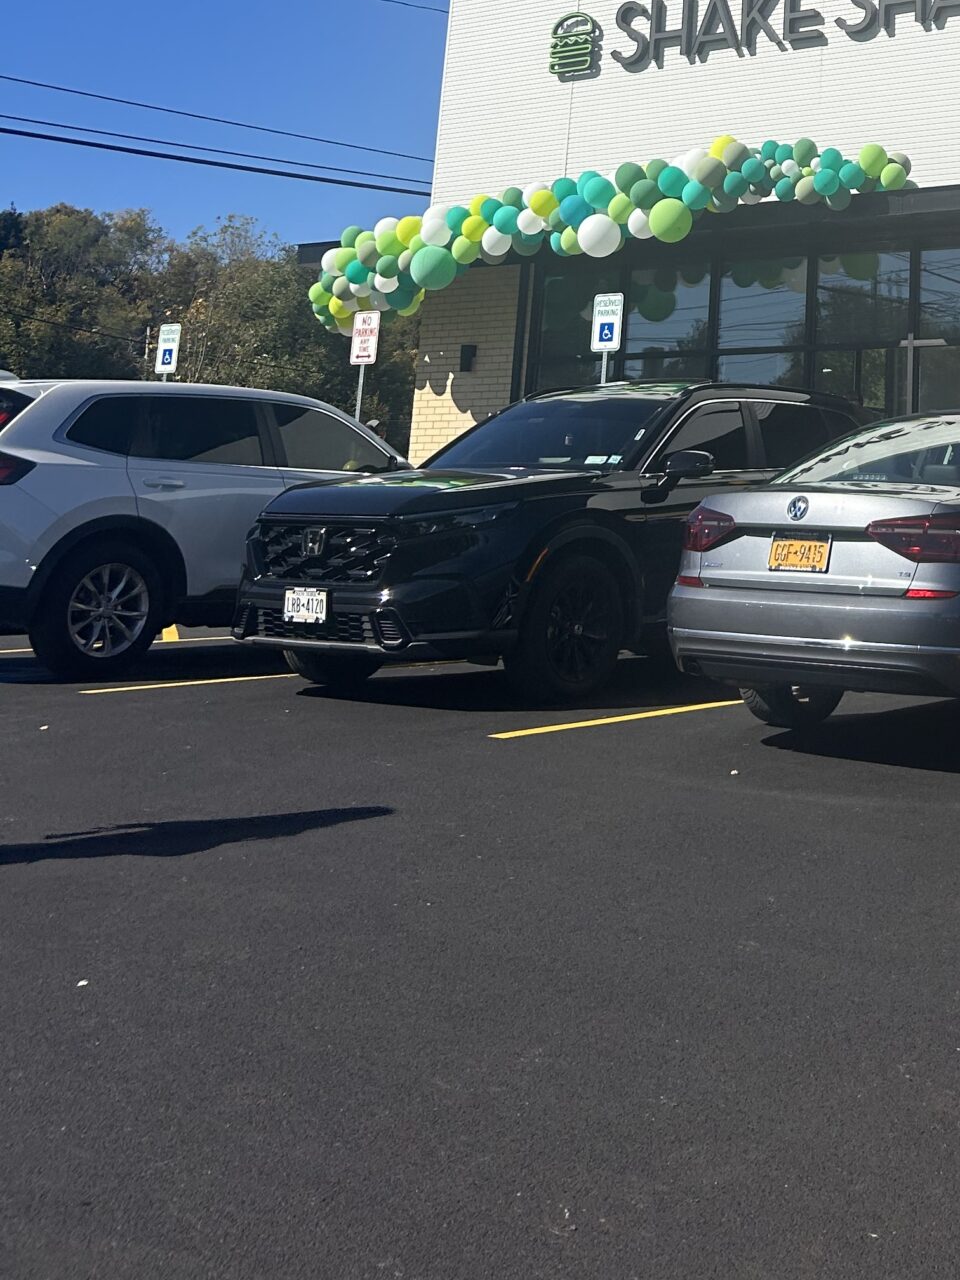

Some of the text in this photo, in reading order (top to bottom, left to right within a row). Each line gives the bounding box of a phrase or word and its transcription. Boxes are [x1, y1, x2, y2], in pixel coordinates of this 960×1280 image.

[595, 298, 621, 307] RESERVED
[597, 309, 619, 317] PARKING
[361, 315, 372, 326] NO
[355, 327, 377, 337] PARKING
